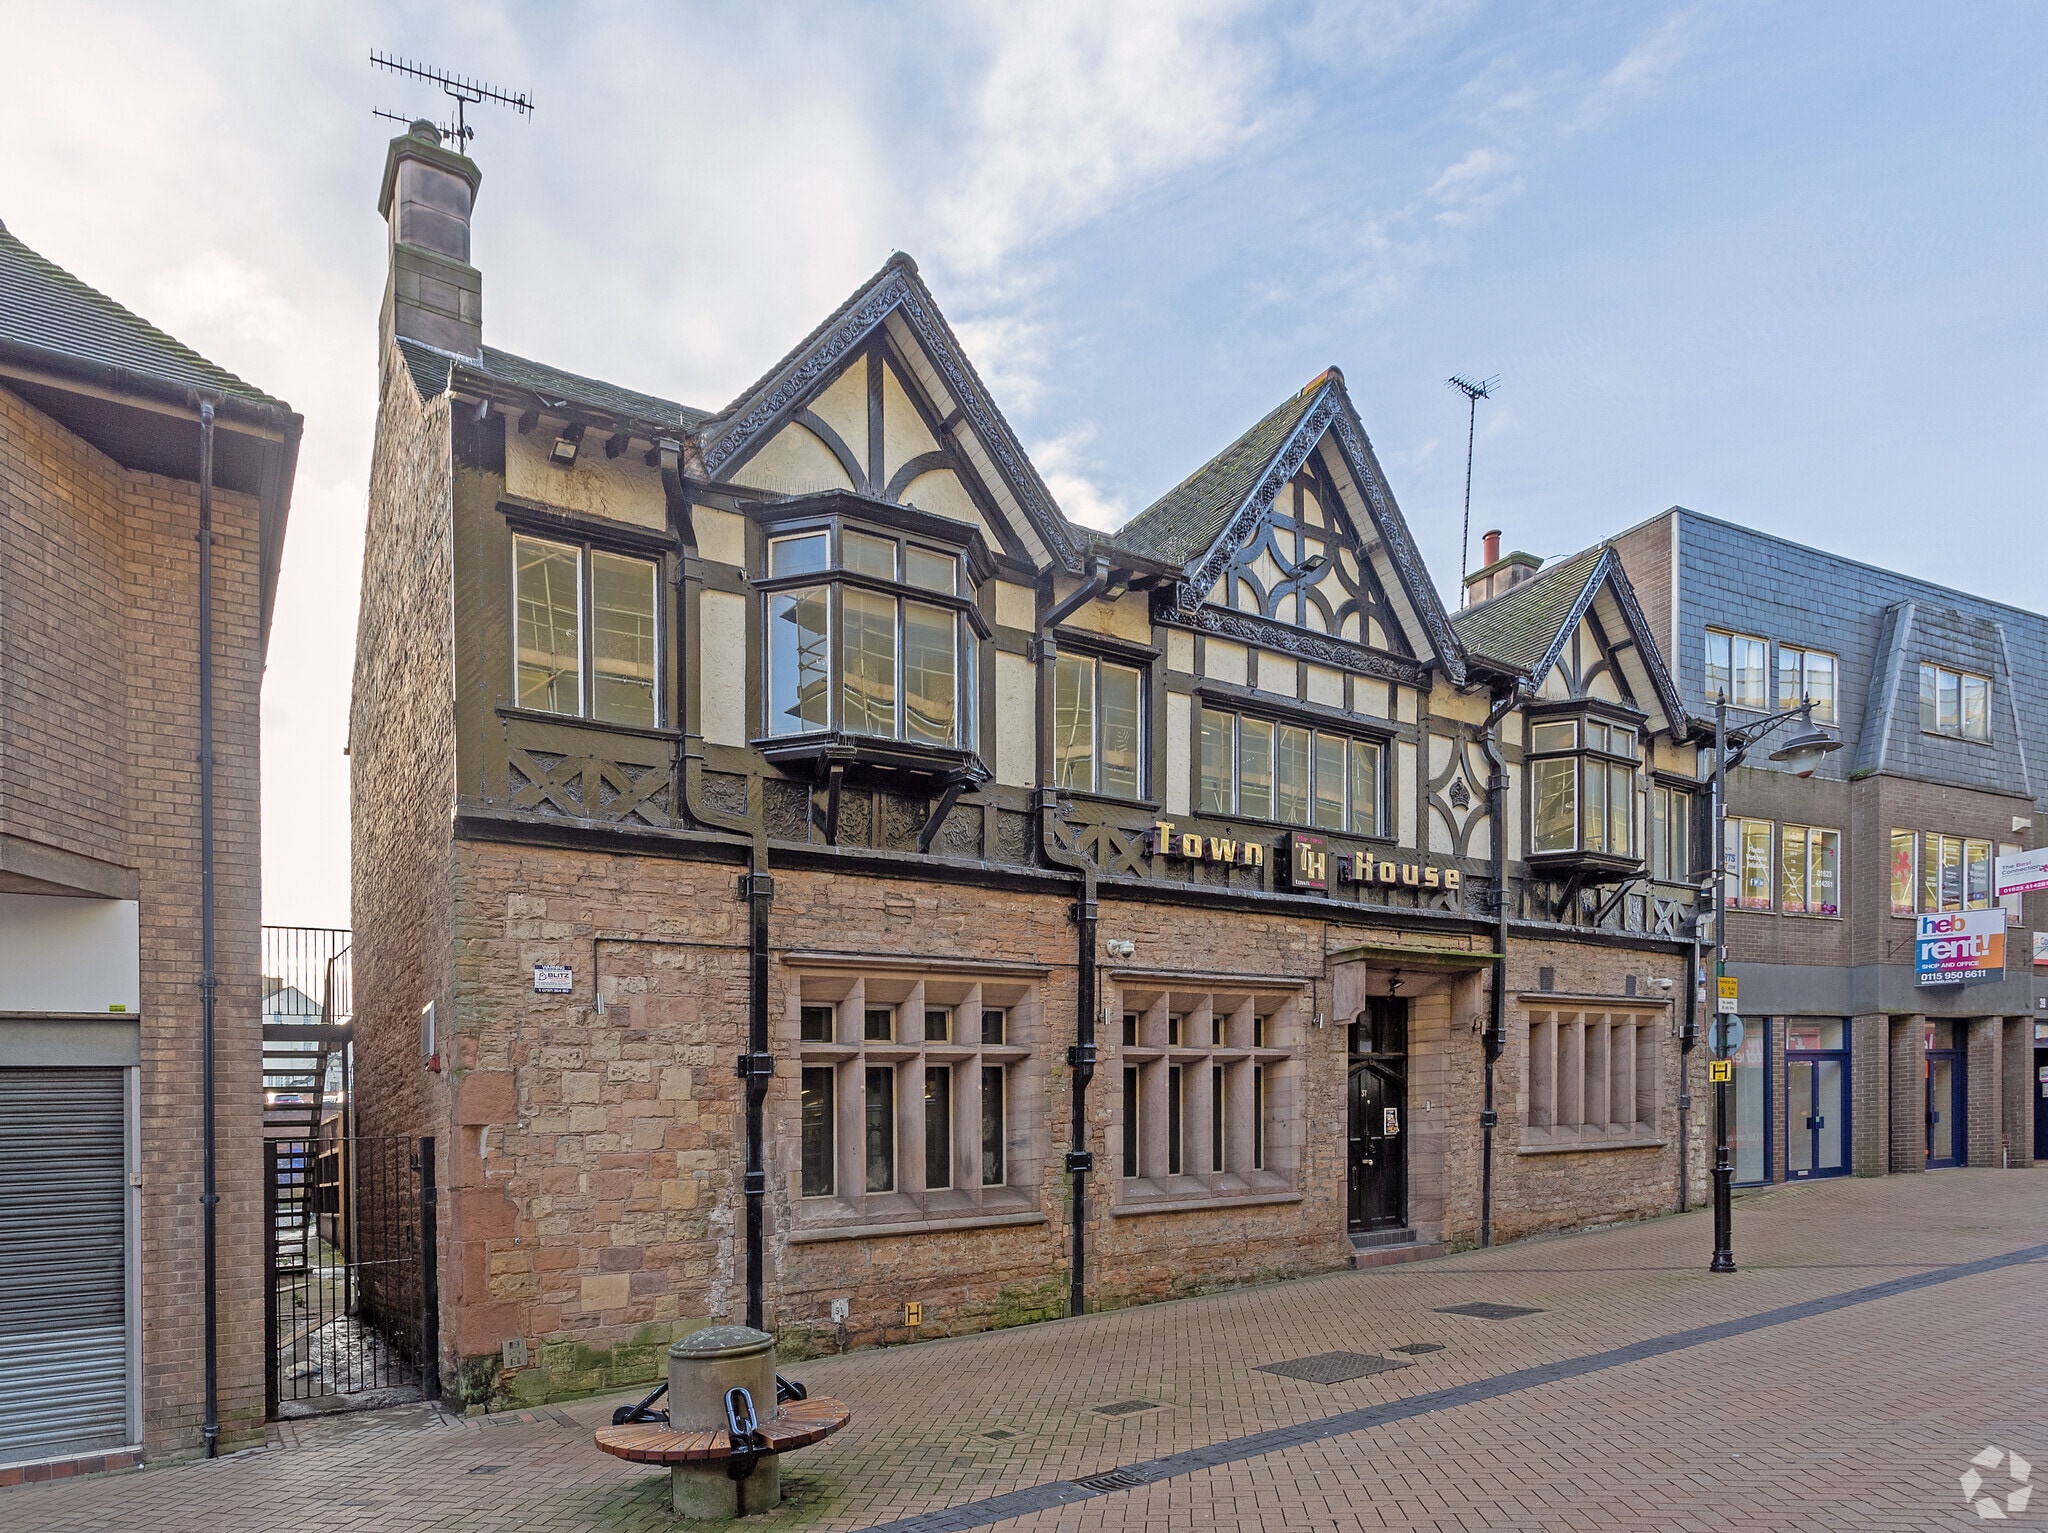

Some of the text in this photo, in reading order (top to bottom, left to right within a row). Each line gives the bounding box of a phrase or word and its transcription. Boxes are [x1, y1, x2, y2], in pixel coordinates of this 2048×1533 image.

[1155, 820, 1460, 890] Town House
[2001, 864, 2041, 876] Connection
[1922, 914, 1966, 934] heb
[1921, 933, 1990, 960] rent!
[1921, 969, 1986, 981] 0115 950 6611
[1713, 1063, 1728, 1080] H
[907, 1304, 920, 1324] H
